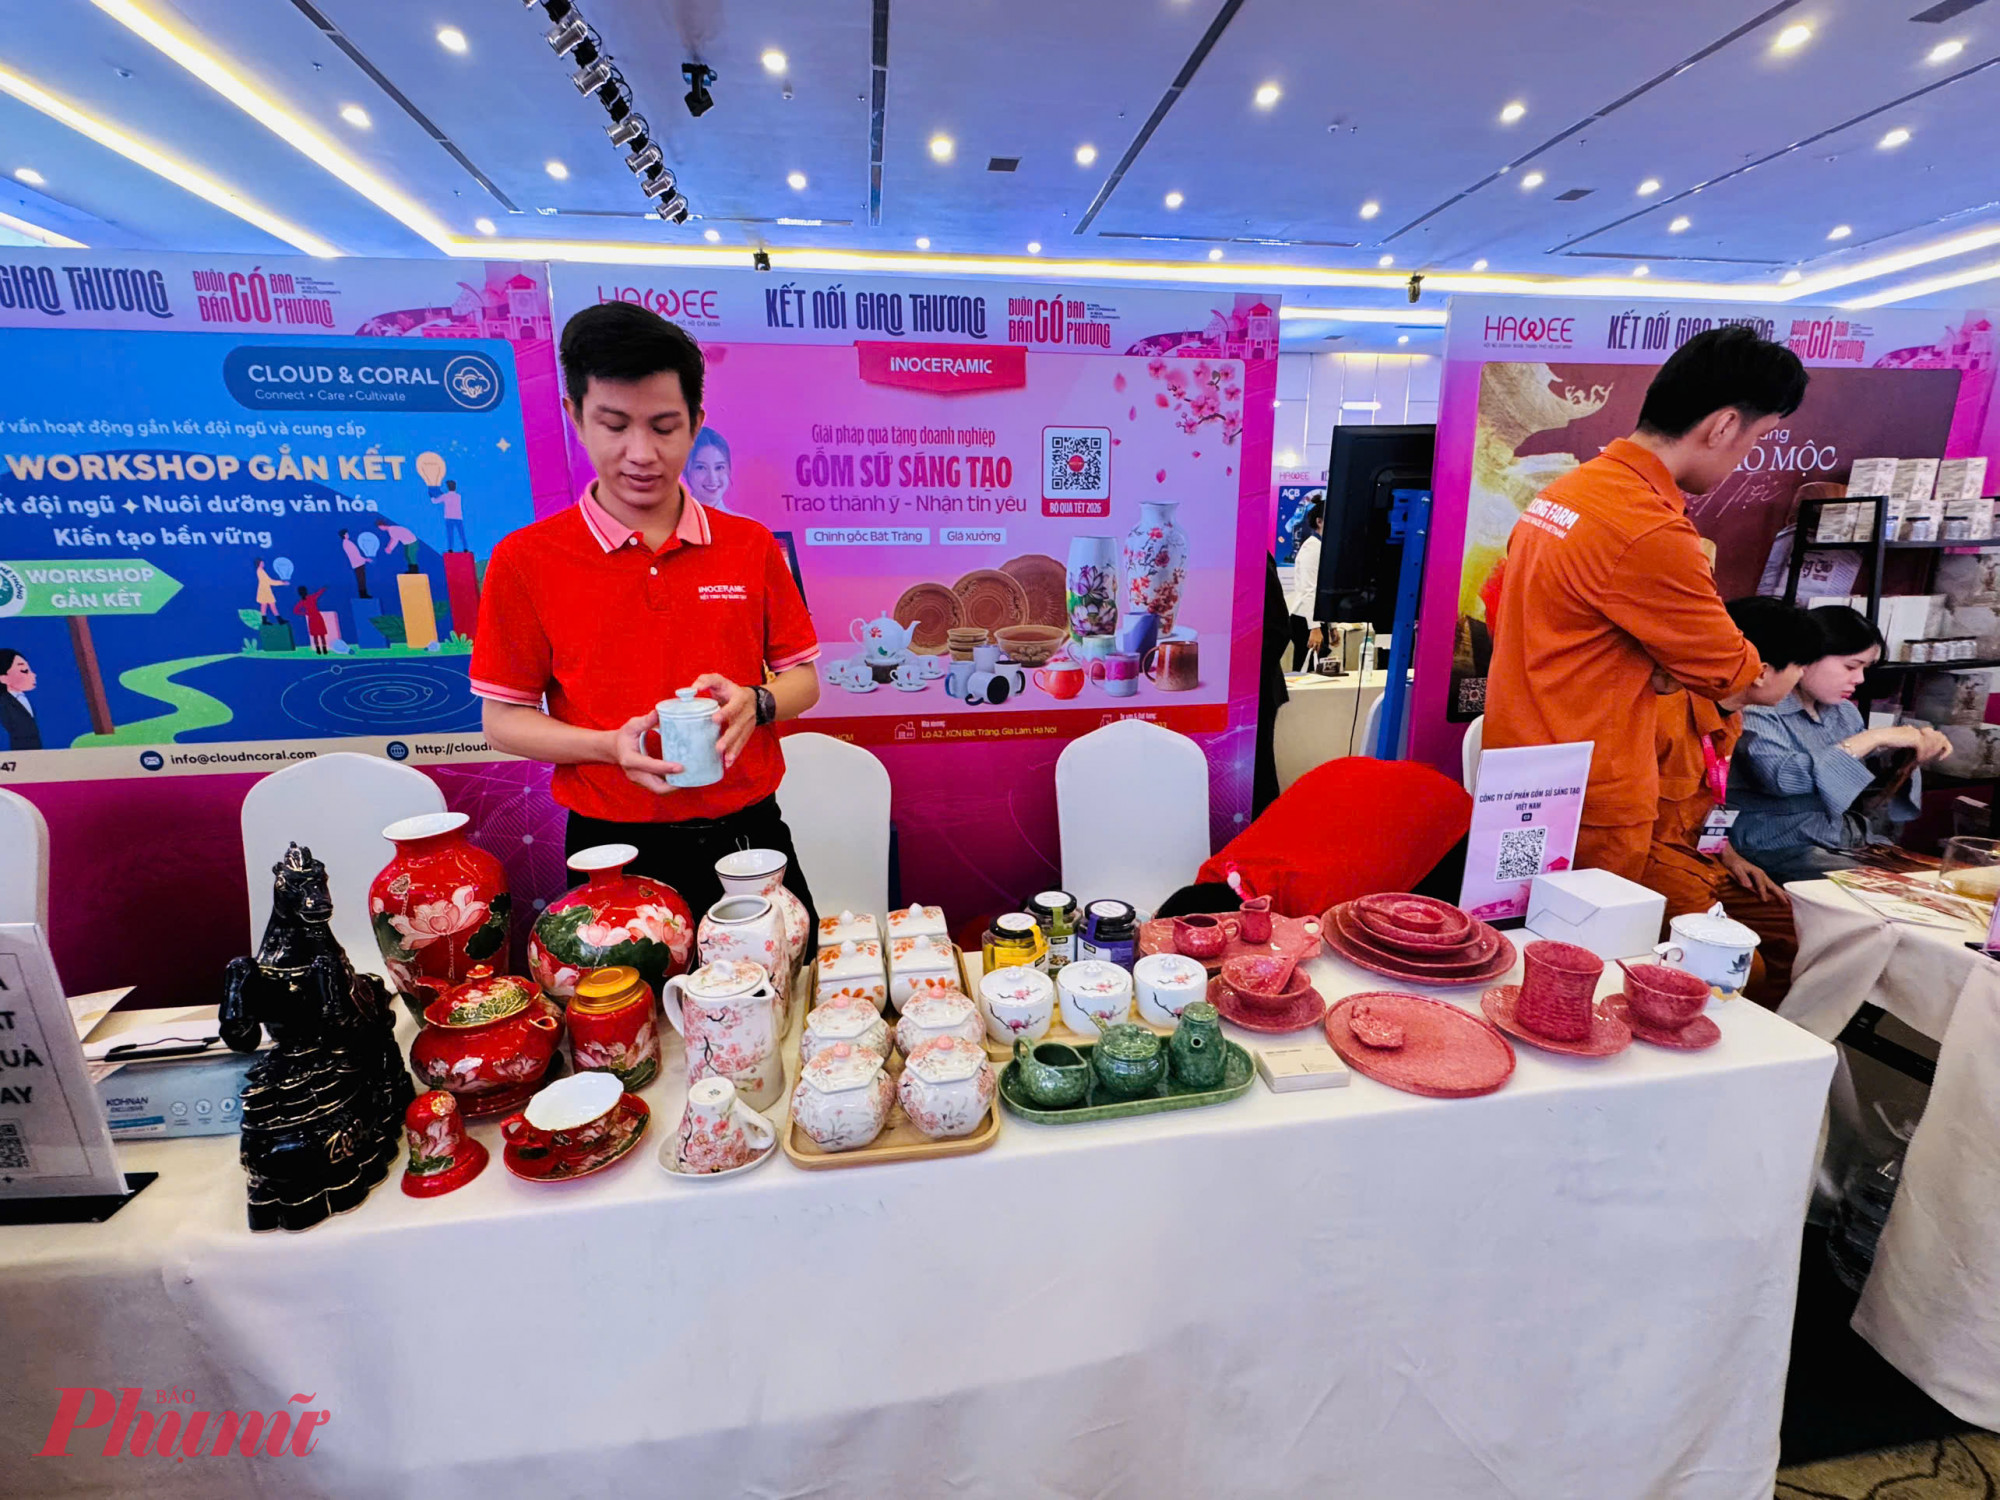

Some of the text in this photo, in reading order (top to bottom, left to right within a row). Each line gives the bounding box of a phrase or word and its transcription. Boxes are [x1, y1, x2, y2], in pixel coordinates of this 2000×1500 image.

[62, 267, 174, 318] THƯƠNG
[228, 266, 272, 323] CÓ
[198, 293, 233, 322] BÁN
[766, 282, 988, 340] KẾT NỐI GIAO THƯƠNG
[1008, 296, 1032, 316] BUÔN
[1035, 294, 1064, 344] CÓ
[1008, 317, 1111, 348] BÁN PHƯỜNG
[1484, 316, 1575, 342] HAWEE
[1608, 310, 1641, 349] KẾT
[1642, 310, 1670, 350] NỐI
[1807, 316, 1834, 358] CÓ
[248, 365, 440, 385] CLOUD & CORAL
[255, 389, 406, 402] Connect Care Cultivate
[44, 420, 84, 437] hoạt
[88, 420, 134, 438] động
[174, 418, 200, 434] kết
[204, 420, 232, 438] đội
[235, 422, 266, 438] ngũ
[270, 422, 289, 435] và
[292, 424, 332, 438] cung
[336, 420, 366, 438] cấp
[920, 425, 955, 446] doanh
[958, 427, 996, 448] nghiệp
[4, 454, 240, 481] WORKSHOP
[338, 443, 406, 481] KẾT
[796, 447, 1012, 492] GỐM SỨ SÁNG TẠO
[1768, 439, 1838, 476] MỘC
[782, 494, 826, 512] Trao
[916, 495, 962, 514] Nhận
[967, 495, 991, 512] tin
[996, 495, 1026, 514] yêu
[1282, 488, 1300, 498] ACB
[22, 494, 62, 519] đội
[68, 495, 116, 518] ngũ
[142, 494, 202, 514] Nuôi
[207, 494, 286, 517] dưỡng
[289, 494, 331, 512] văn
[336, 495, 378, 512] hóa
[1545, 504, 1580, 530] FARM
[53, 524, 272, 550] Kiến tạo bền vững
[25, 567, 155, 584] WORKSHOP
[102, 586, 143, 607] KẾT
[171, 749, 318, 765] info@cloudncoral.com
[1480, 792, 1496, 803] CÔNG
[1529, 802, 1542, 810] NAM
